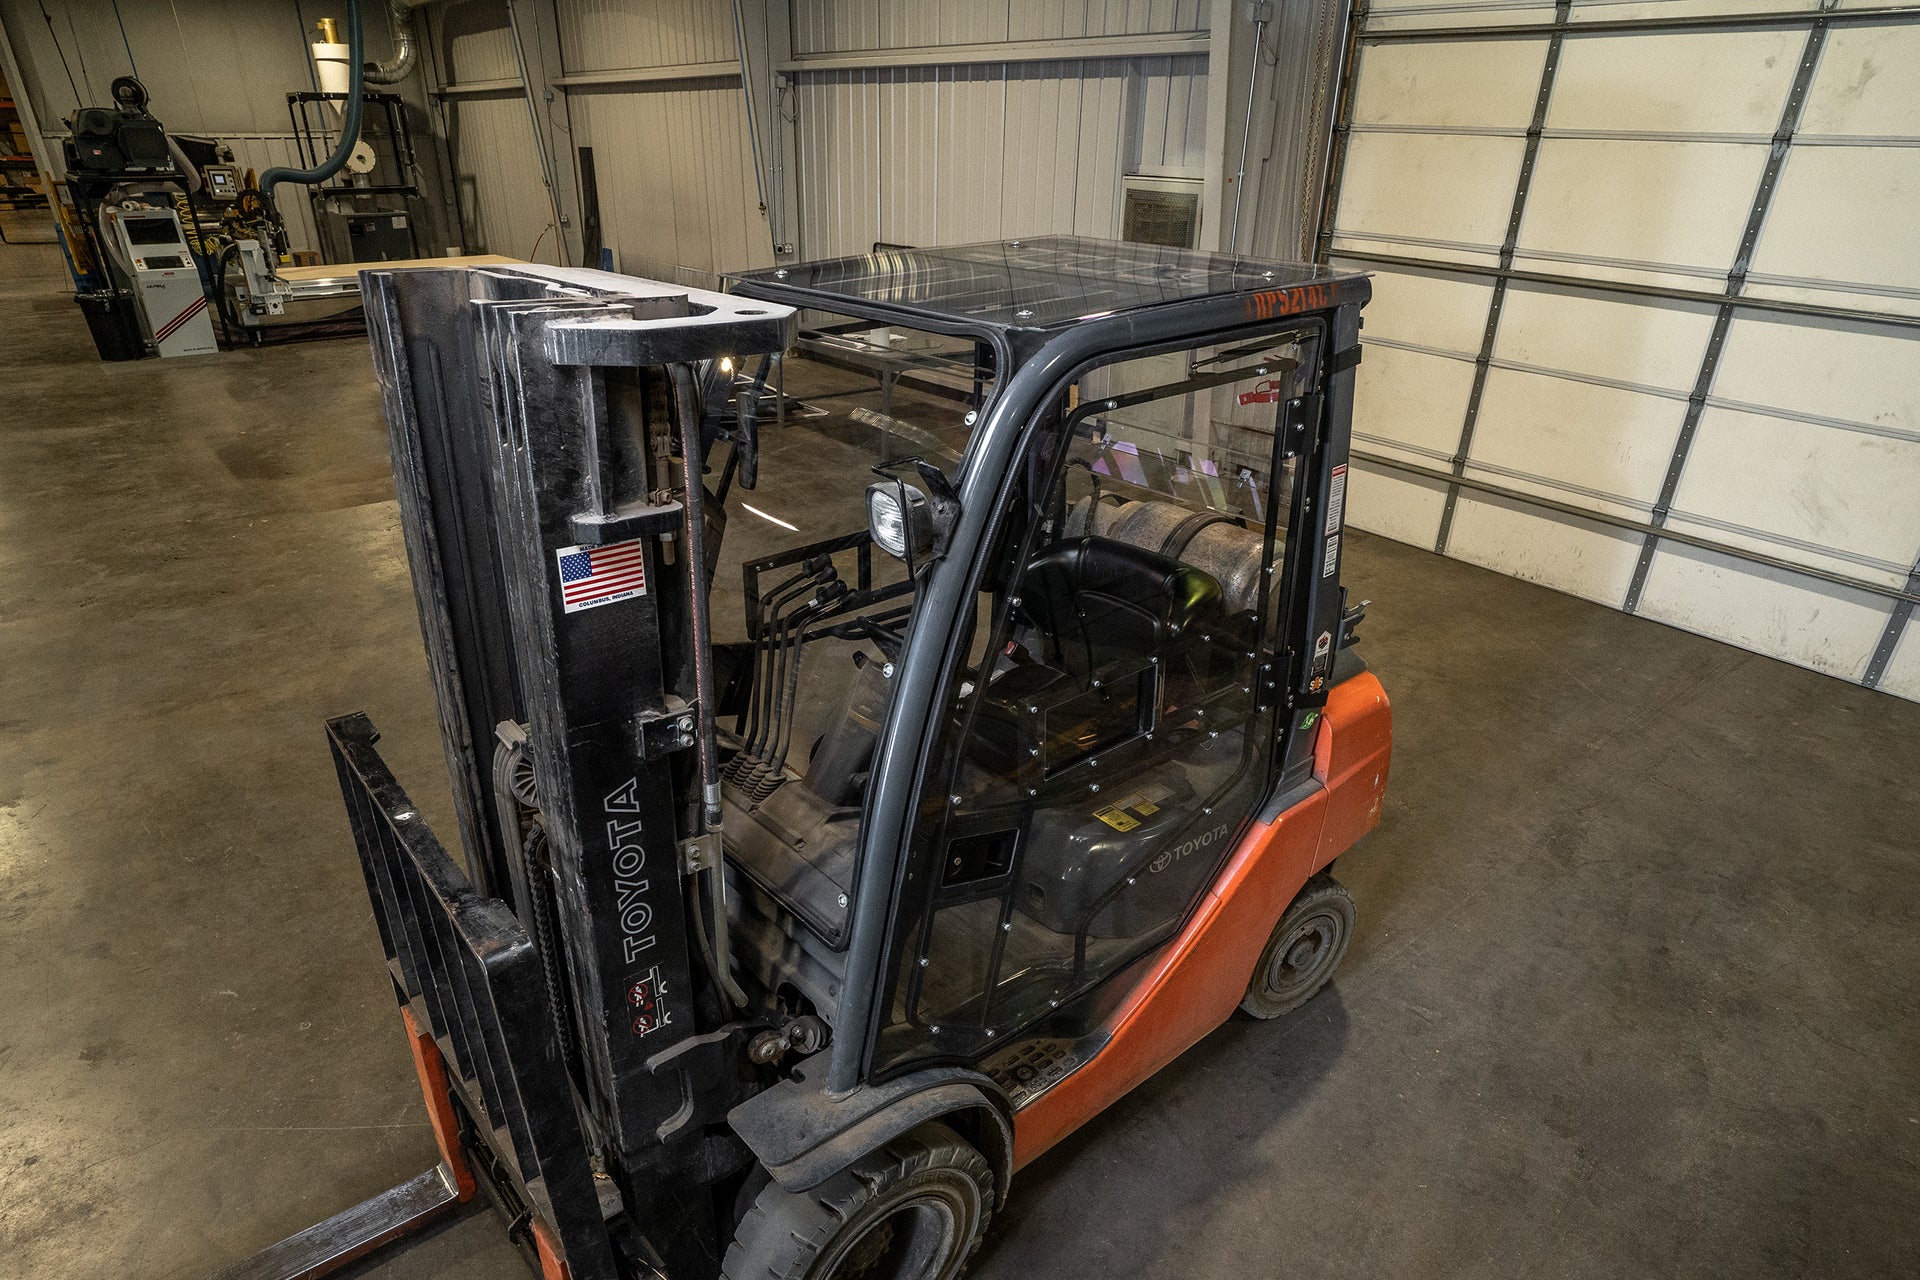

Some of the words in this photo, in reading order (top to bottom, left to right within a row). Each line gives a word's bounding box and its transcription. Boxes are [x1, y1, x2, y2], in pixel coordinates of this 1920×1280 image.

[578, 596, 611, 608] COLUMBUS,
[611, 590, 634, 601] INDIANA
[1173, 823, 1228, 861] TOYOTA
[603, 776, 656, 965] TOYOTA
